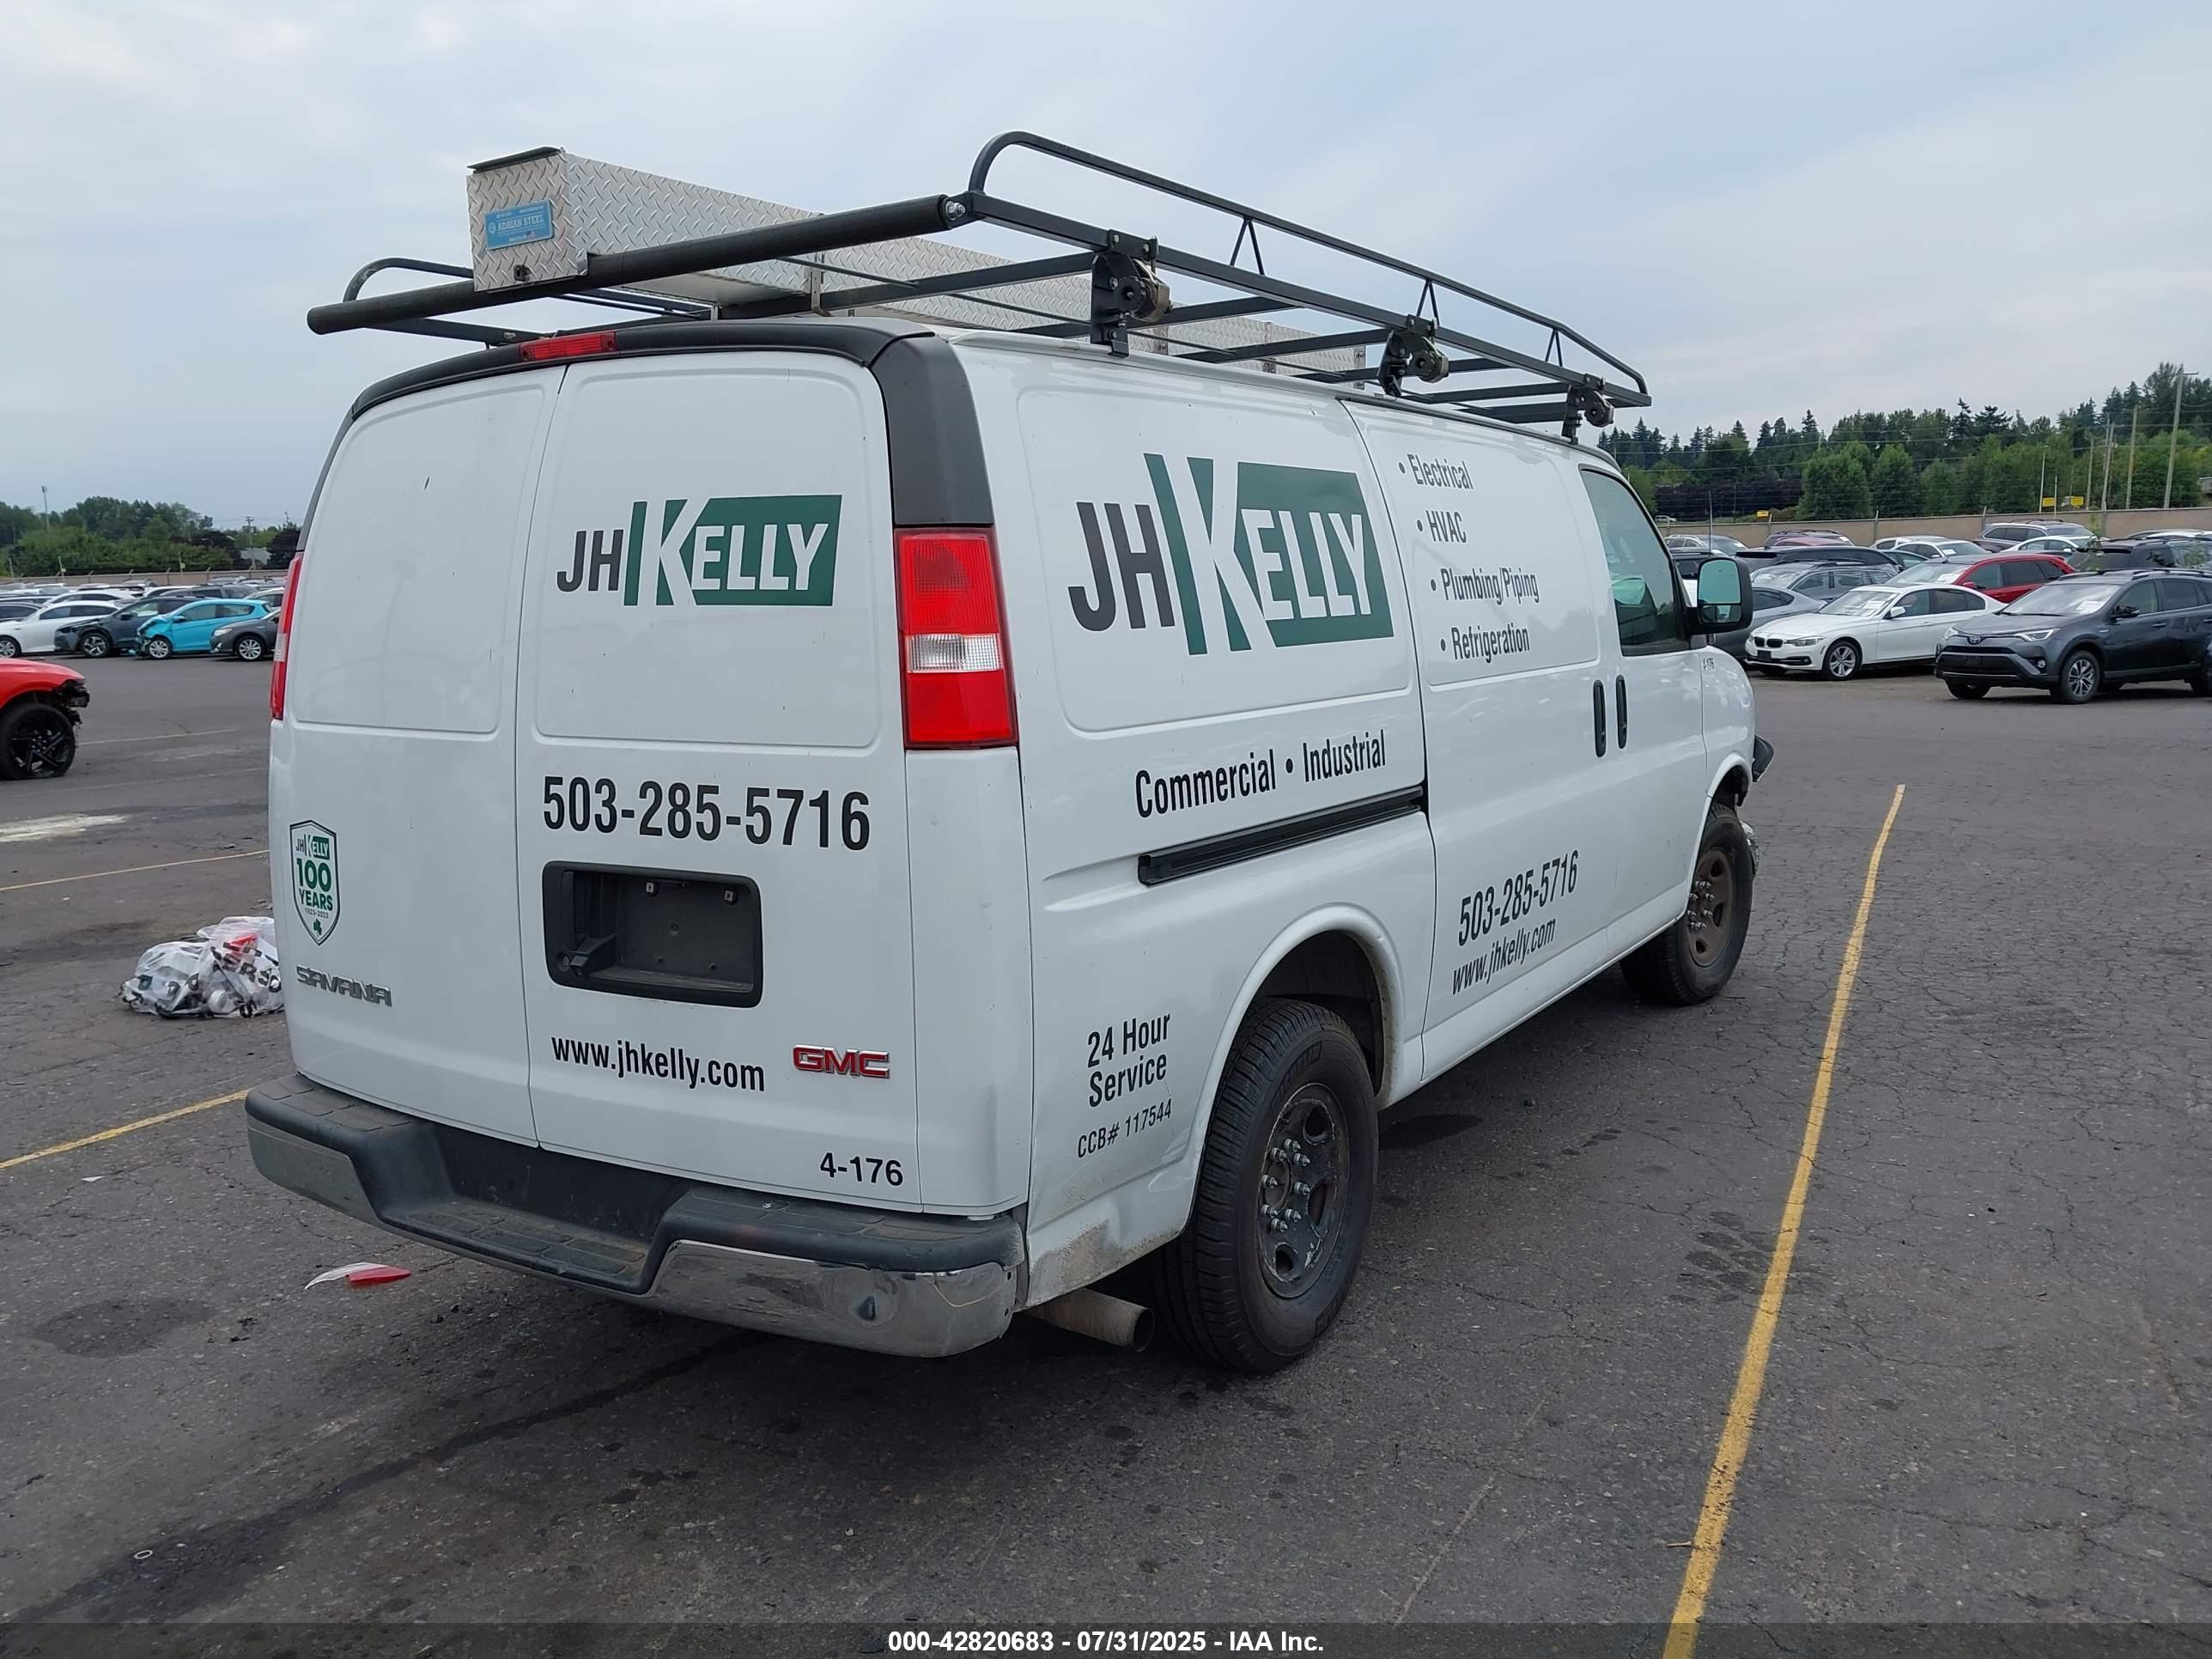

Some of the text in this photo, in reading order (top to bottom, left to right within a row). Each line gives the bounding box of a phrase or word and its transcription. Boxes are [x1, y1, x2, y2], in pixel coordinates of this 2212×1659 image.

[1407, 453, 1474, 489] Electrical
[1425, 509, 1467, 544] HVAC
[1440, 567, 1540, 605] Plumbing/Piping
[1451, 622, 1530, 664] Refrigeration
[1135, 728, 1387, 818] Commercial Industrial
[544, 775, 871, 851] 503-285-5716
[296, 858, 331, 892] 100
[299, 888, 333, 911] YEARS
[1458, 849, 1578, 946] 503-285-5716
[1452, 918, 1556, 996] www.jhkelly.com
[296, 964, 392, 1007] SAVANA
[793, 1044, 890, 1079] GMC
[1087, 1013, 1170, 1068] 24 Hour
[551, 1036, 765, 1091] www.jhkelly.com
[1089, 1054, 1167, 1108] Service
[1078, 1098, 1172, 1158] CCB# 117544
[818, 1152, 903, 1186] 4-176
